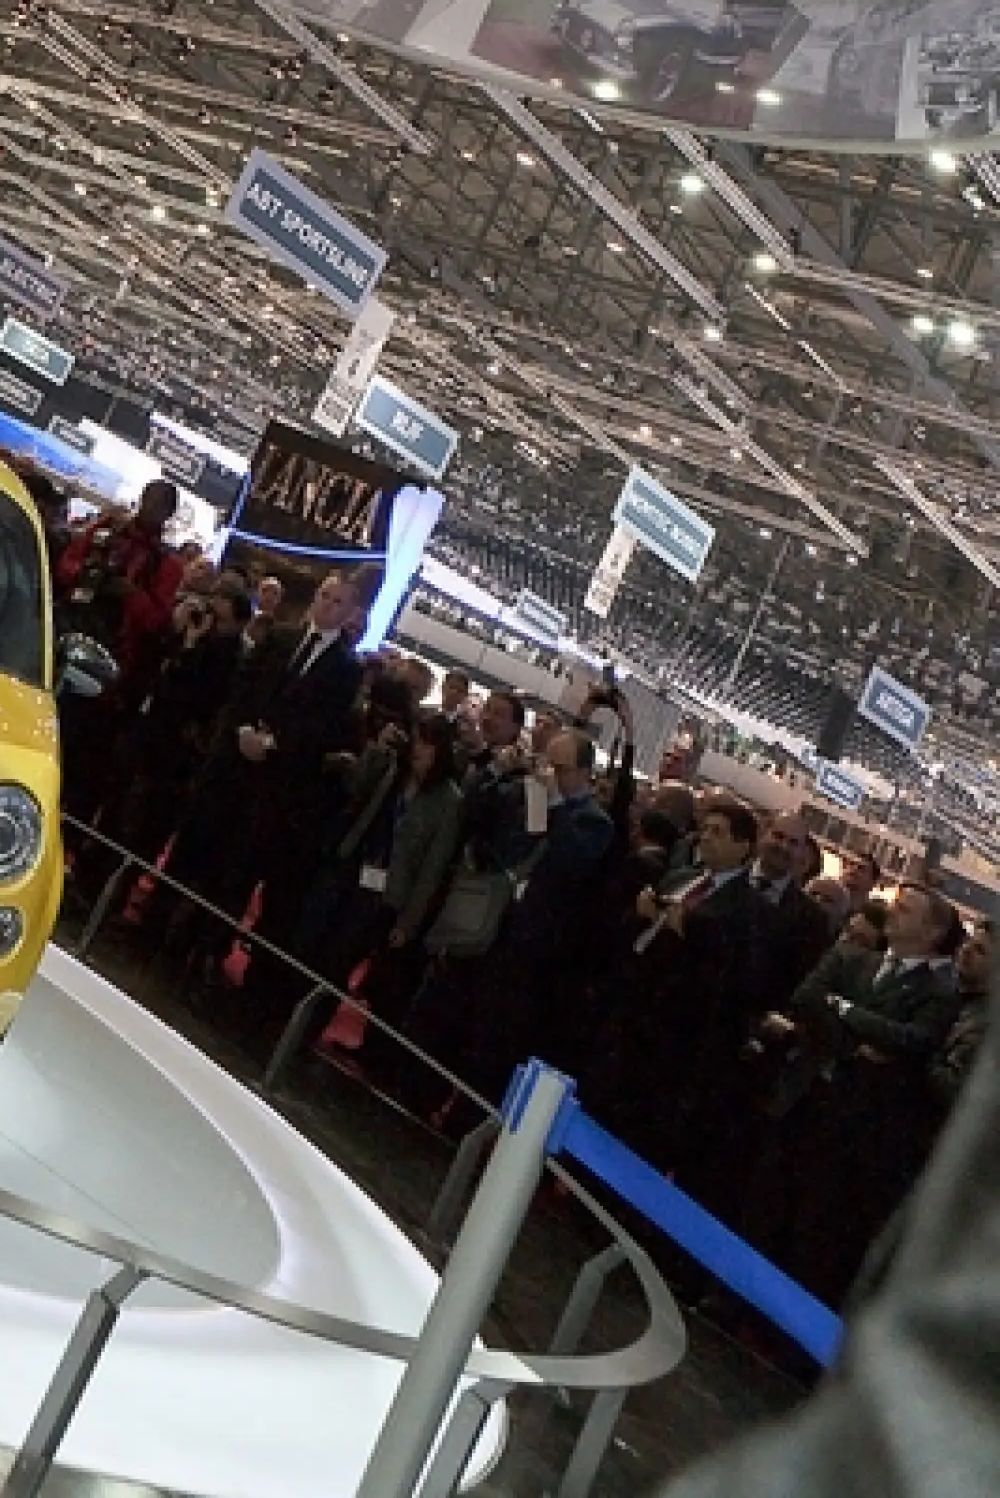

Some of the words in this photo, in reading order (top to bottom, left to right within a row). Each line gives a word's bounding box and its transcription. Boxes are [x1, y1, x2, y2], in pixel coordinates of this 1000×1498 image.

[246, 181, 282, 219] ABT
[280, 205, 370, 289] SPORTSLINE
[256, 443, 377, 547] LANCIA
